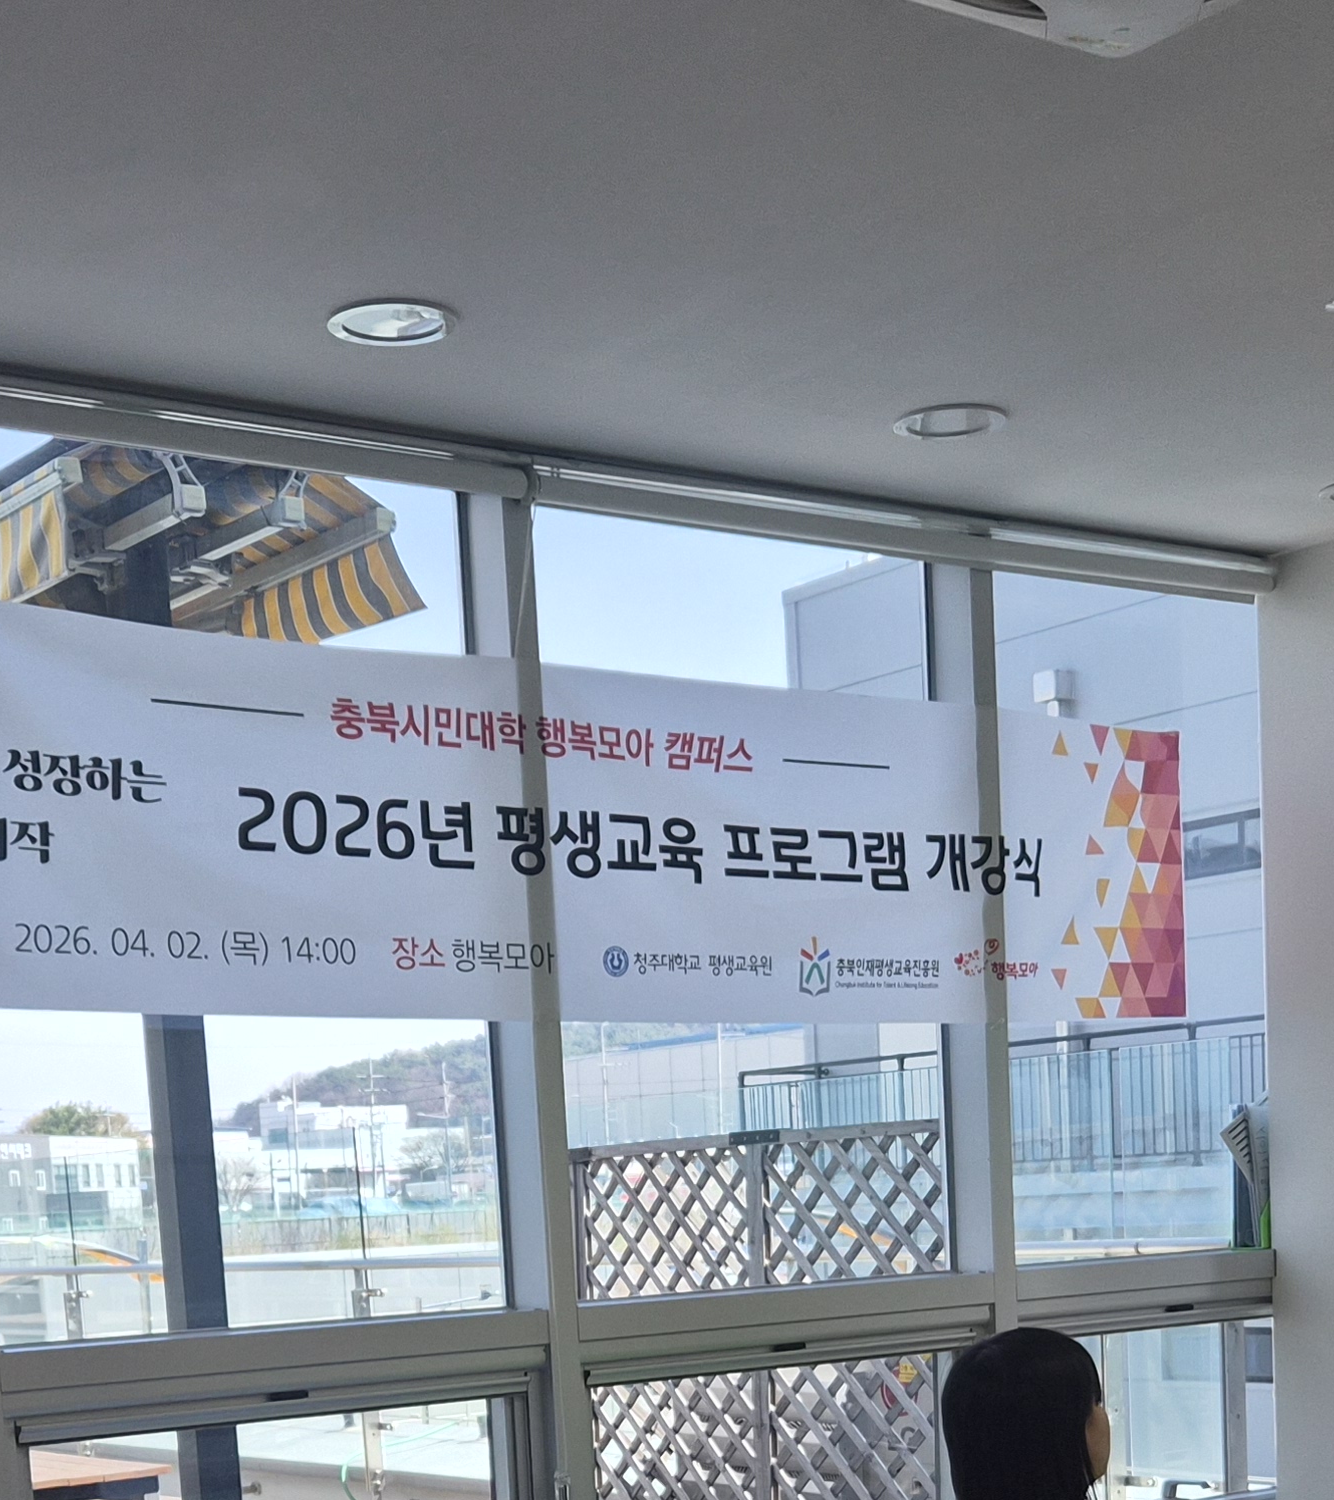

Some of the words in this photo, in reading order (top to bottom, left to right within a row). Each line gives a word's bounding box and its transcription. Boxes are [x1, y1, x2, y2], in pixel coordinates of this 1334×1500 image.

[329, 697, 527, 755] 충북시민대학
[535, 715, 654, 767] 행복모아
[663, 730, 754, 773] 캠퍼스
[2, 749, 167, 803] 성장하는
[237, 786, 475, 870] 2026년
[496, 805, 704, 884] 평생교육
[723, 824, 909, 892] 프로그램
[925, 833, 1042, 897] 개강식
[15, 923, 98, 955] 2026.
[111, 928, 156, 958] 04.
[167, 930, 209, 960] 02.
[221, 929, 268, 966] (목)
[281, 936, 357, 966] 14:00
[391, 936, 446, 971] 장소
[451, 939, 555, 974] 행복모아
[633, 952, 701, 975] 청주대학교
[708, 953, 772, 976] 평생교육원
[836, 958, 939, 978] 충북인재평생교육진흥원
[991, 961, 1039, 982] 행복모아
